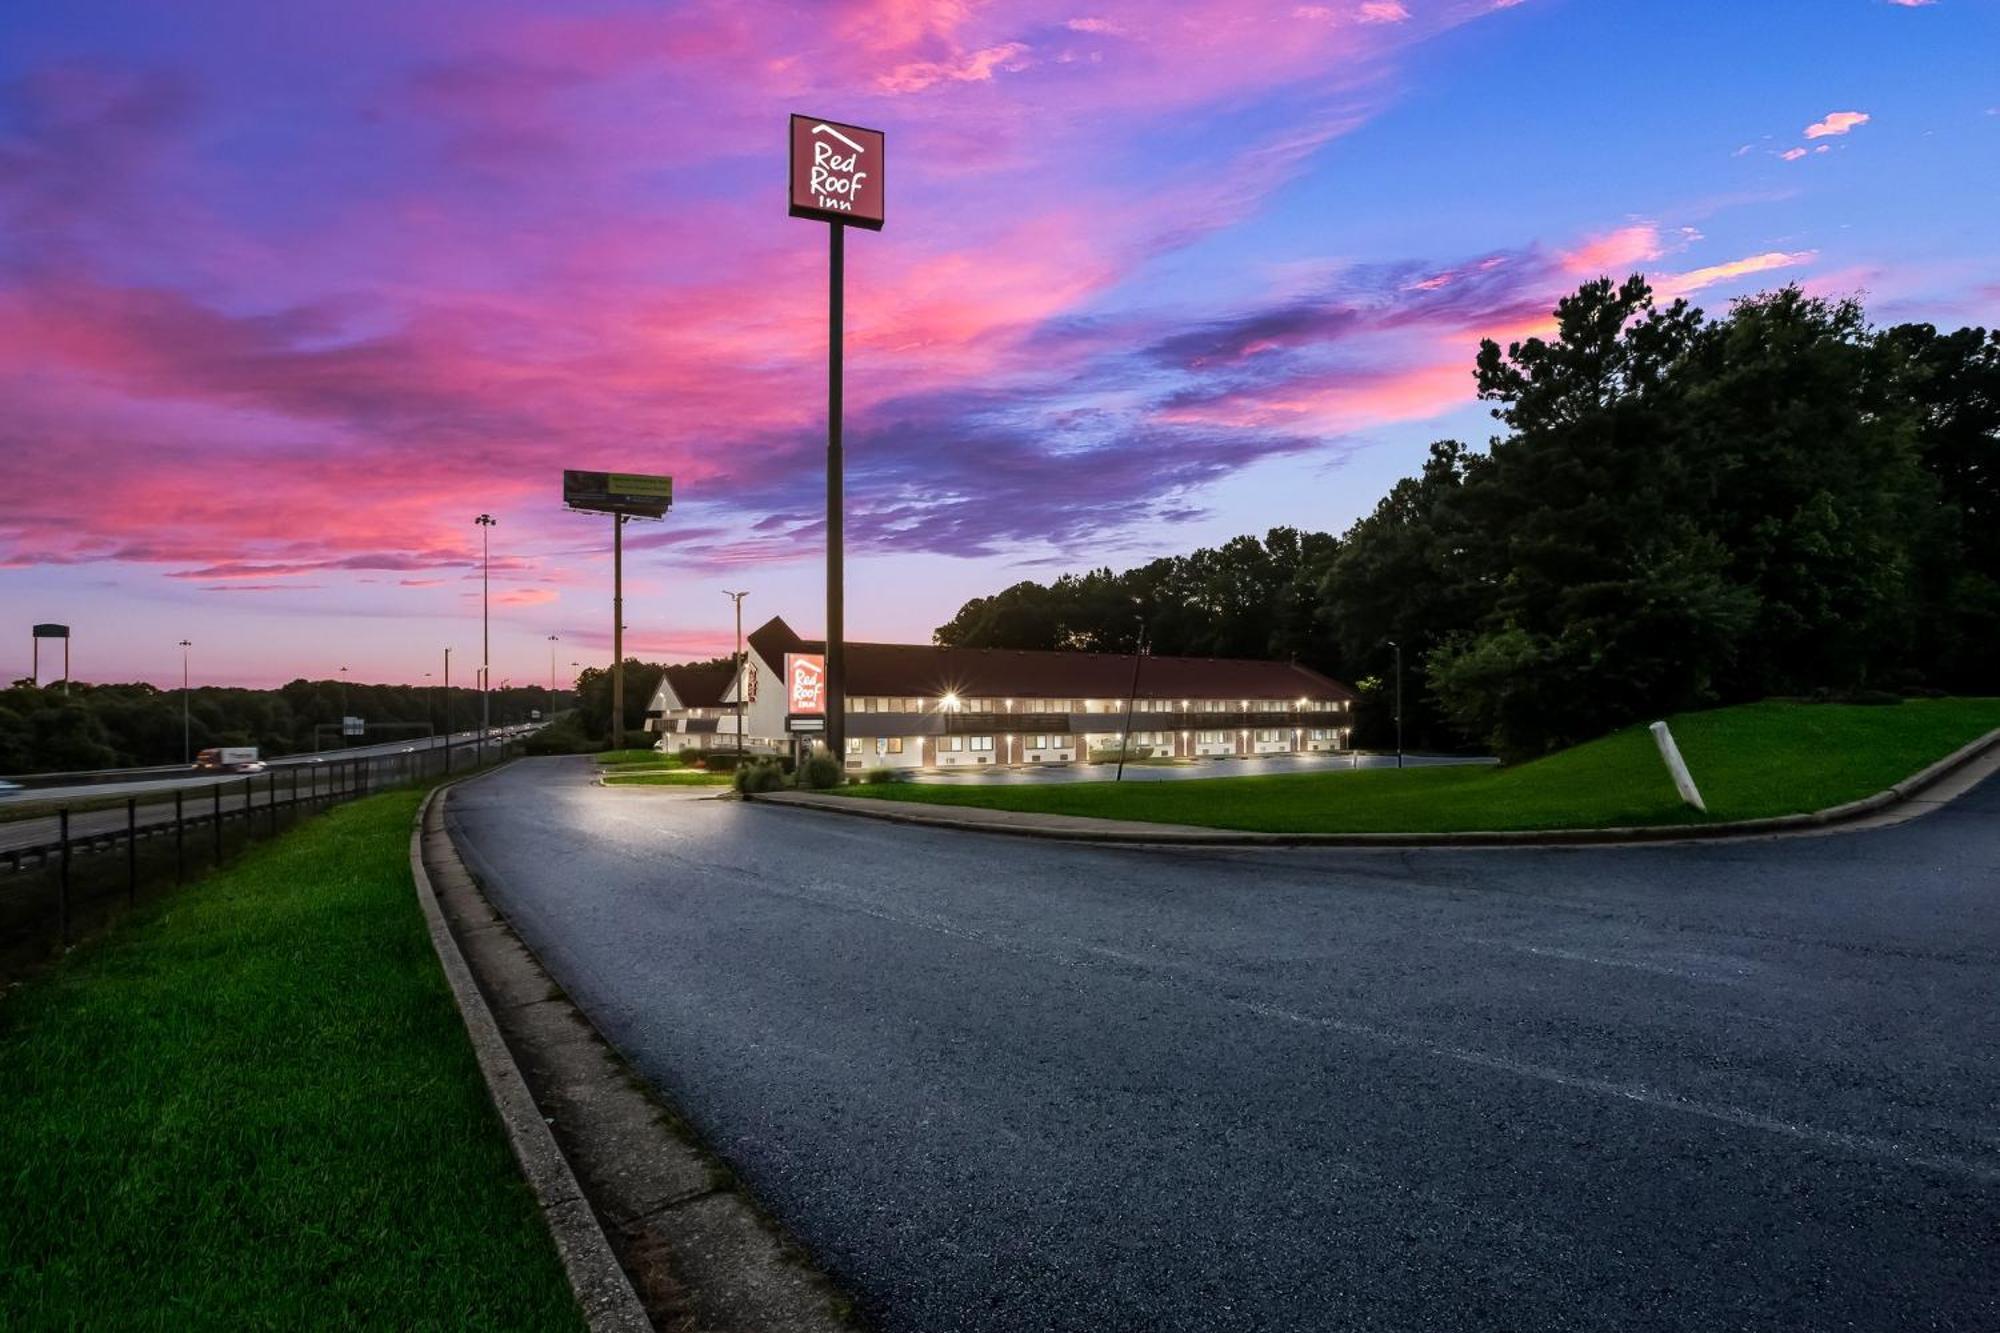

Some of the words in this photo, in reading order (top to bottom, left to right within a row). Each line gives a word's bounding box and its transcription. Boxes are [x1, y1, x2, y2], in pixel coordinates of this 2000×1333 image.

[815, 141, 857, 173] Red
[810, 166, 867, 201] Roof
[819, 195, 851, 211] Inn
[795, 669, 818, 687] Red
[793, 683, 822, 702] Roof
